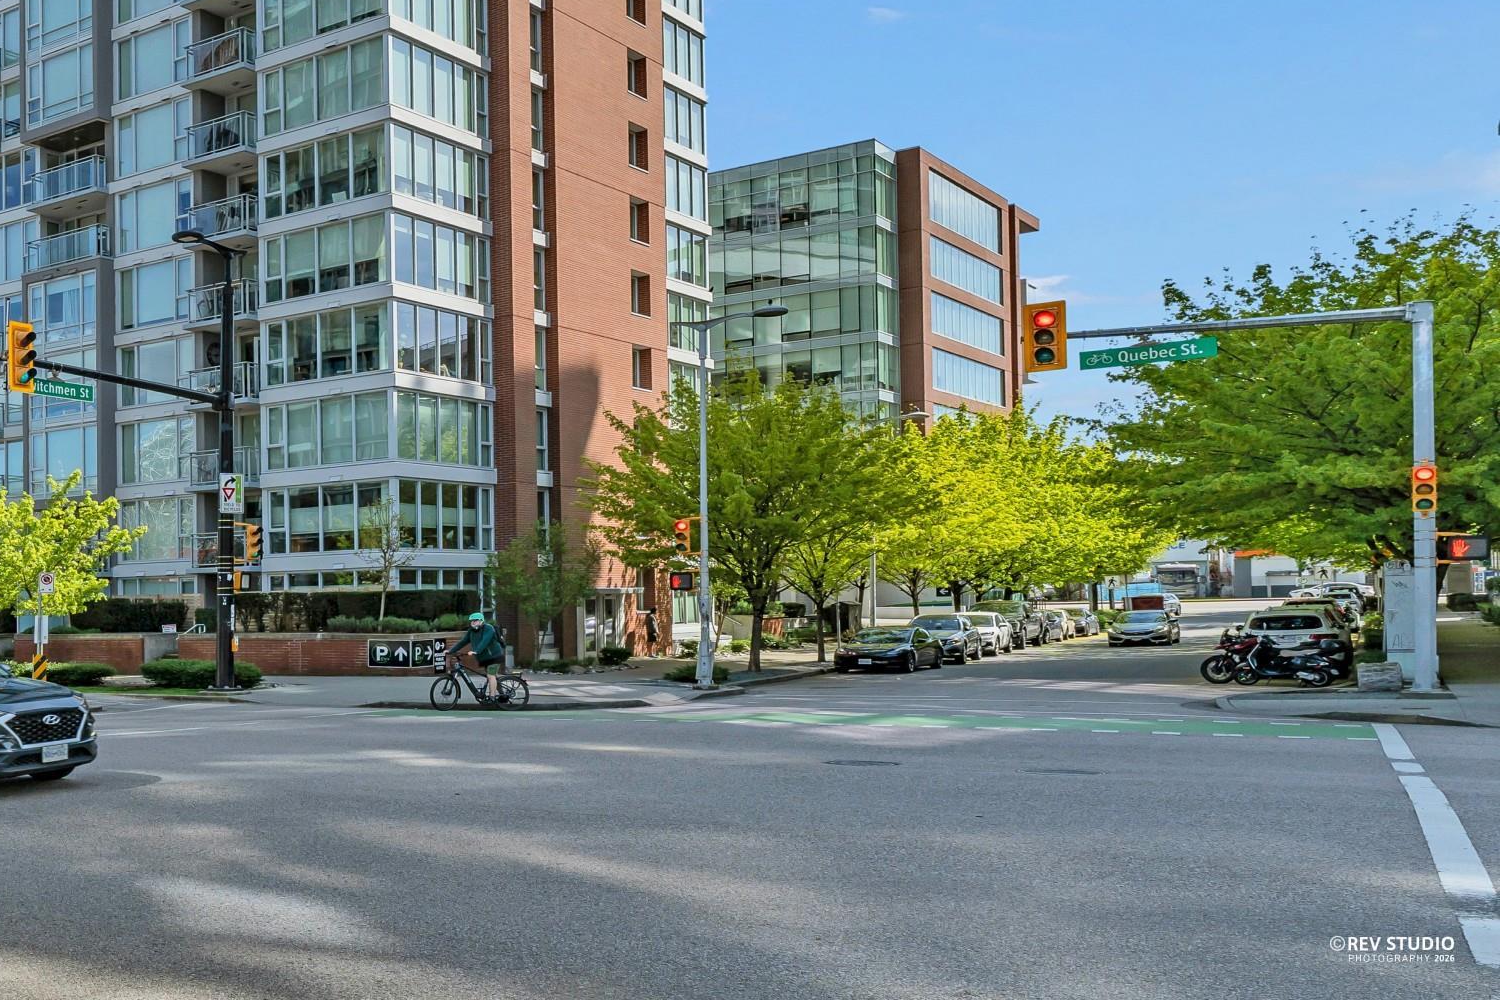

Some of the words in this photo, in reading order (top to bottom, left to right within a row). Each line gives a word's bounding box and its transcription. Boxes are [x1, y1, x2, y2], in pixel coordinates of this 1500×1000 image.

[1117, 347, 1177, 364] Quebec
[1180, 343, 1204, 356] St.
[80, 387, 89, 399] St
[376, 646, 389, 662] P
[415, 646, 422, 661] P
